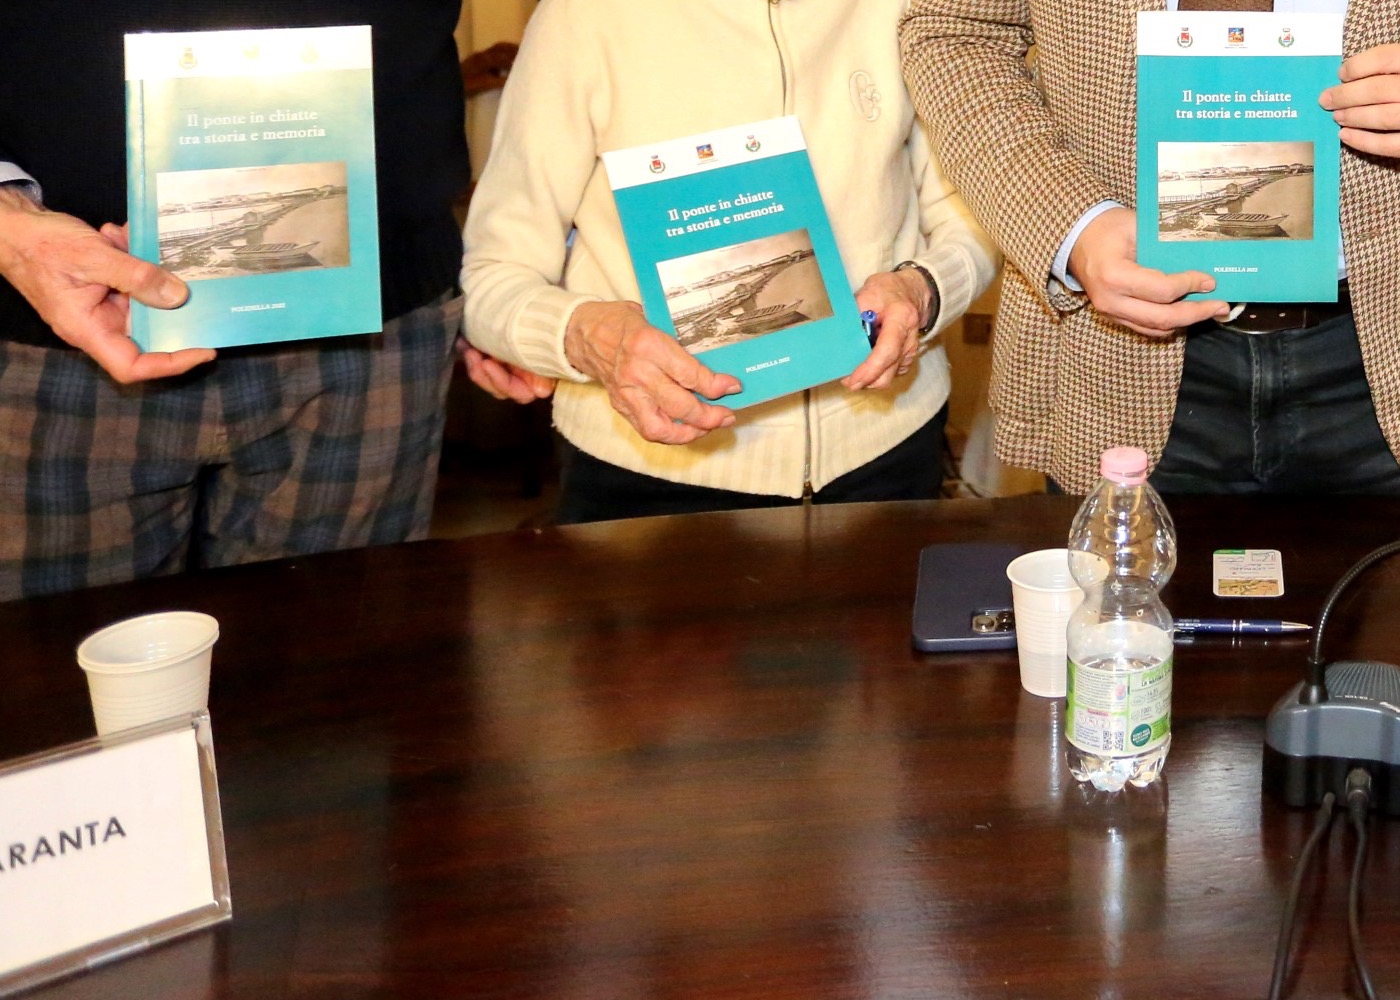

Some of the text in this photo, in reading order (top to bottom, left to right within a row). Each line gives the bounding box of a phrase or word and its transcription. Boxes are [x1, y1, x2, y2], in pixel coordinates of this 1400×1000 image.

[1182, 90, 1292, 105] Il ponte in chiatte
[187, 108, 319, 129] Il ponte in chiatte
[1175, 107, 1298, 119] tra storia e memoria
[179, 125, 327, 145] tra storia e memoria
[667, 189, 775, 222] Il ponte in chiatte
[666, 203, 785, 237] tra storia e memoria
[0, 816, 127, 872] RANTA
